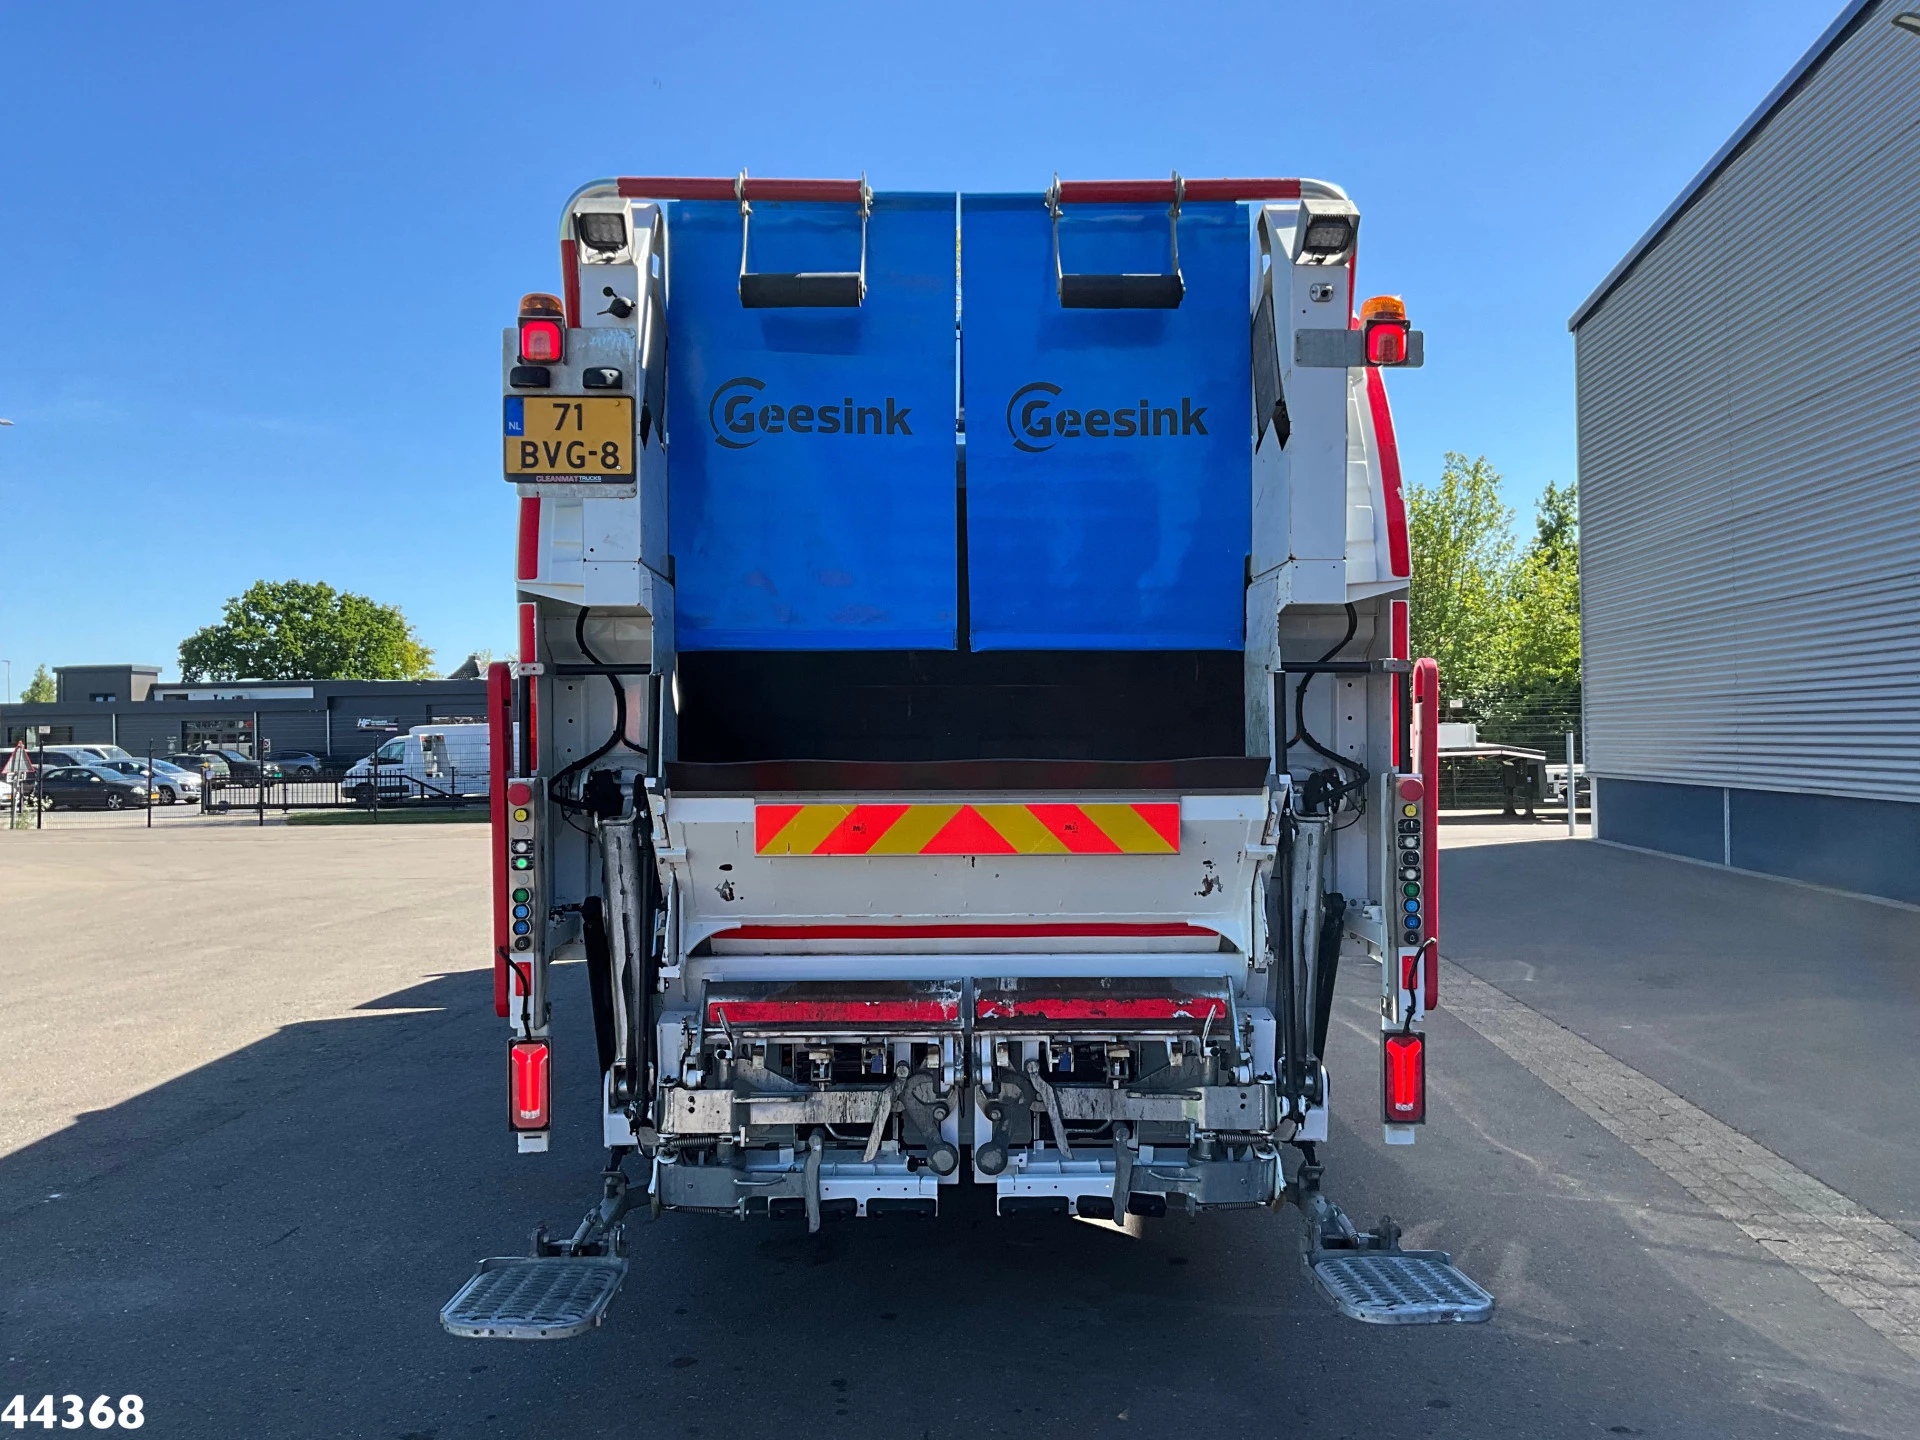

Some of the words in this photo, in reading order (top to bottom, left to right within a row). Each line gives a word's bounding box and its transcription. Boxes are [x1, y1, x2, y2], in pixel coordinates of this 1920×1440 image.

[508, 421, 521, 431] NL
[552, 403, 583, 431] 71
[724, 395, 913, 436] Geesink
[1022, 397, 1208, 437] Geesink
[520, 440, 620, 470] BVG-8
